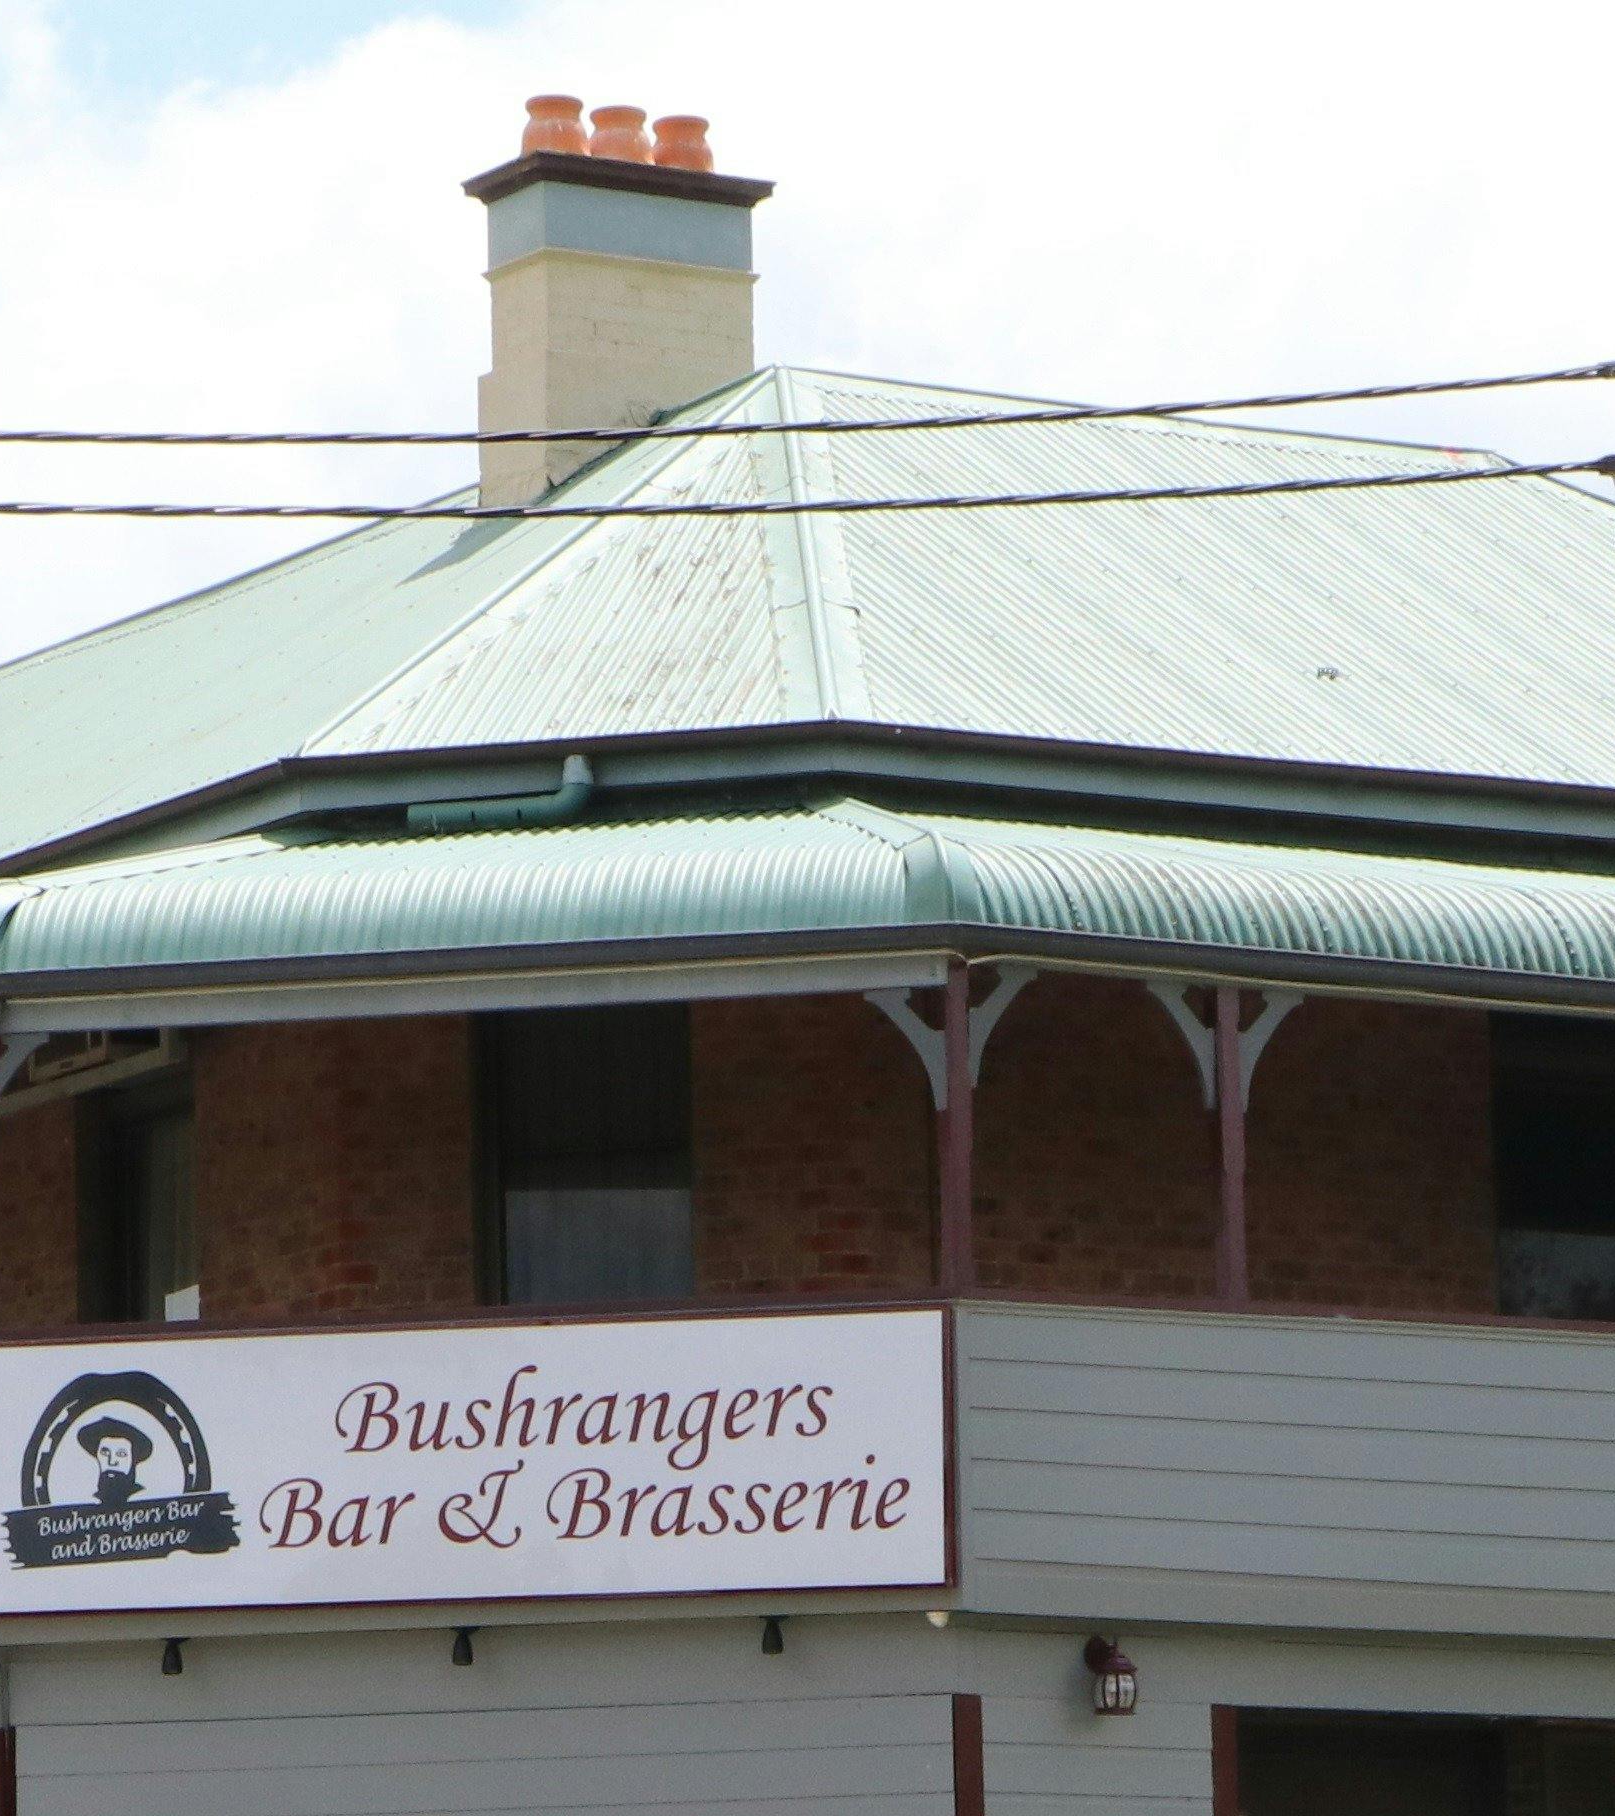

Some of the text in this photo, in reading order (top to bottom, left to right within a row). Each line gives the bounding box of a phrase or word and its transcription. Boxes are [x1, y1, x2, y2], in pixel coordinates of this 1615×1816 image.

[335, 1364, 836, 1470] Bushrangers
[37, 1499, 205, 1537] Bushrangers Bar
[259, 1452, 912, 1549] Bar & Brasserie
[51, 1527, 190, 1560] and Brasserie
